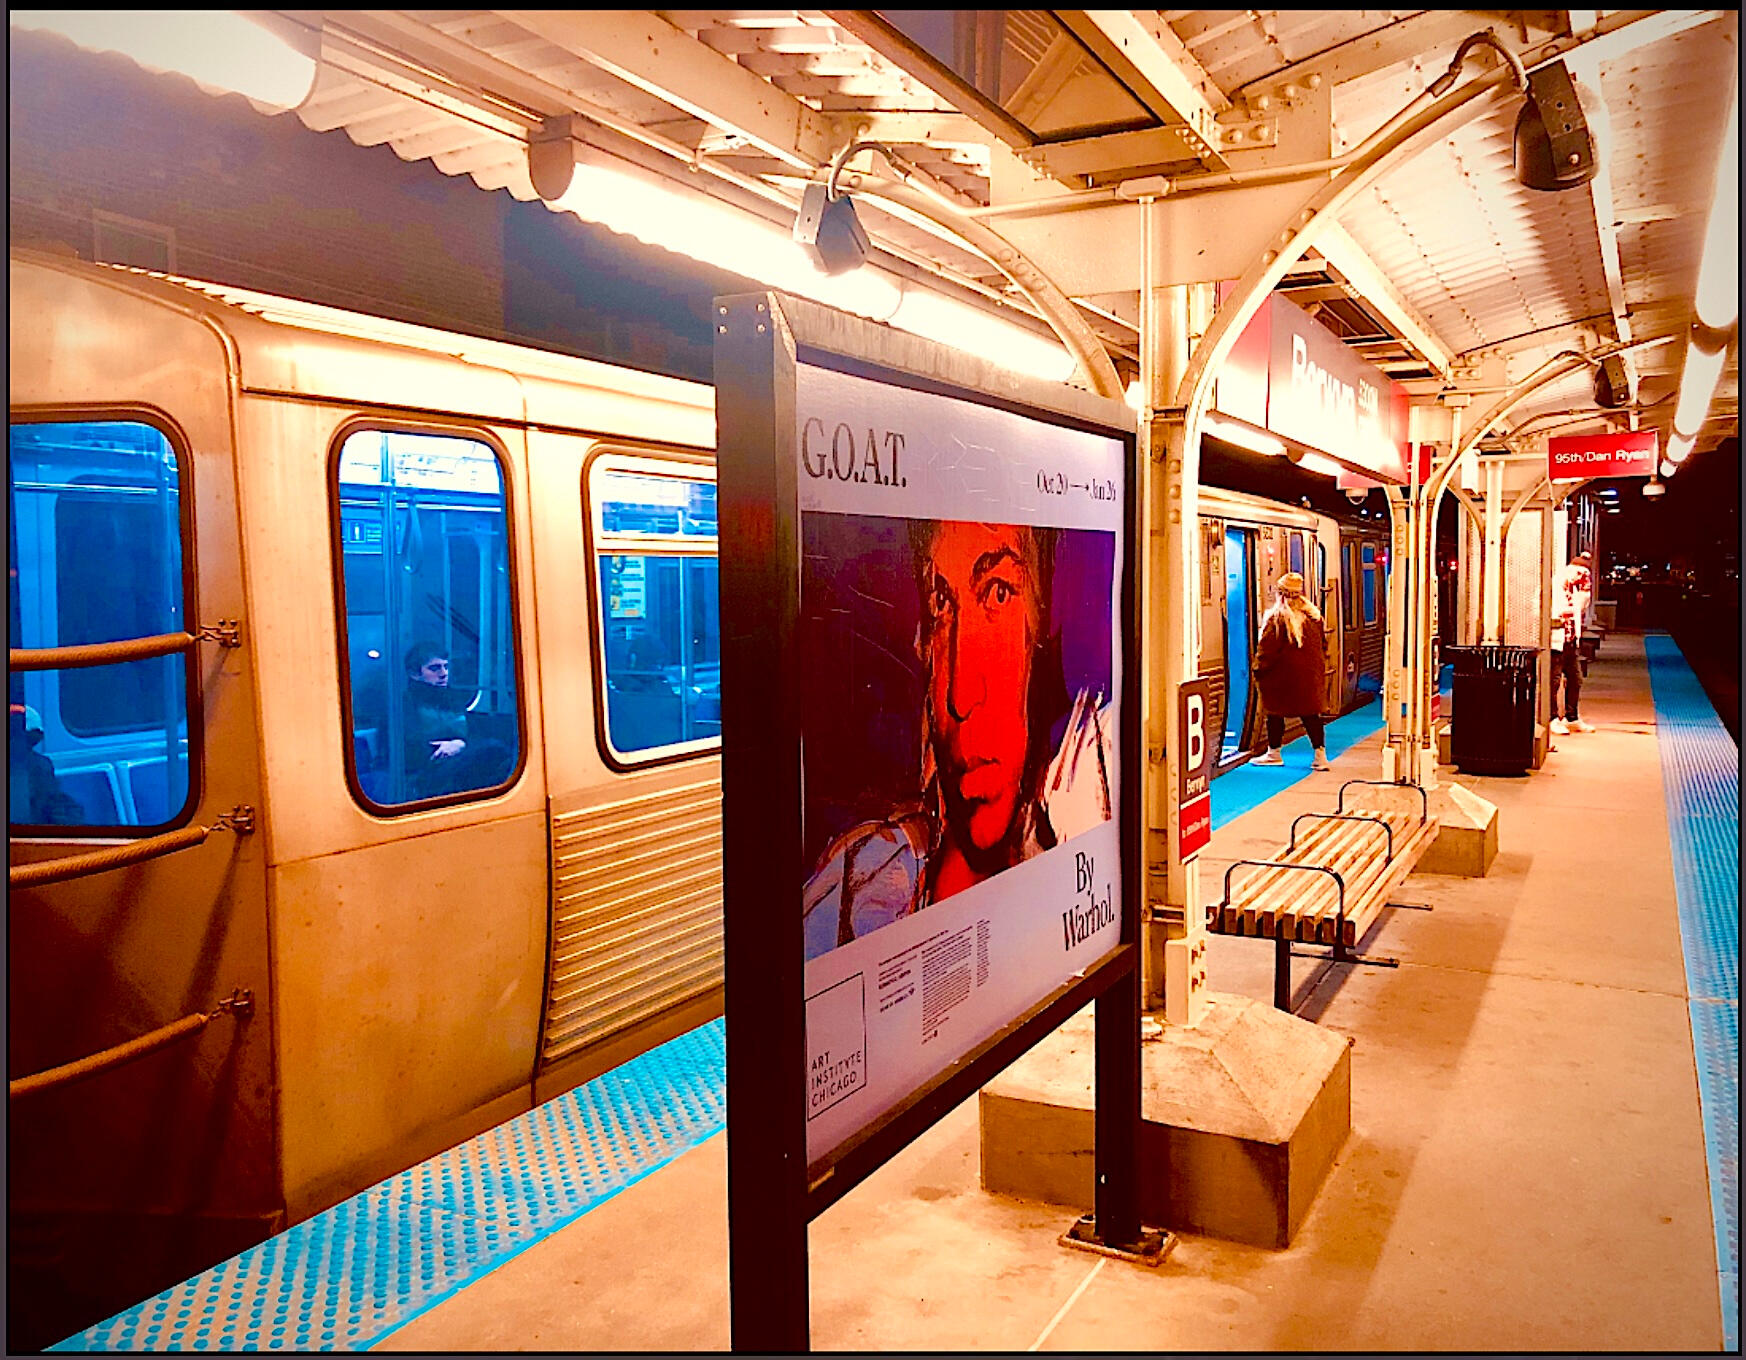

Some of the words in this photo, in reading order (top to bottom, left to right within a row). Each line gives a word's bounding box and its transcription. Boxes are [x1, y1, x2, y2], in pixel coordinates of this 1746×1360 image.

[802, 418, 907, 487] G.O.A.T.
[1554, 450, 1612, 464] 95th/Dan
[1615, 449, 1650, 463] Ryan
[1187, 694, 1205, 772] B
[1075, 851, 1095, 896] By
[1062, 883, 1115, 952] Warhol.
[811, 1051, 830, 1071] ART
[811, 1071, 857, 1107] CHICAGO
